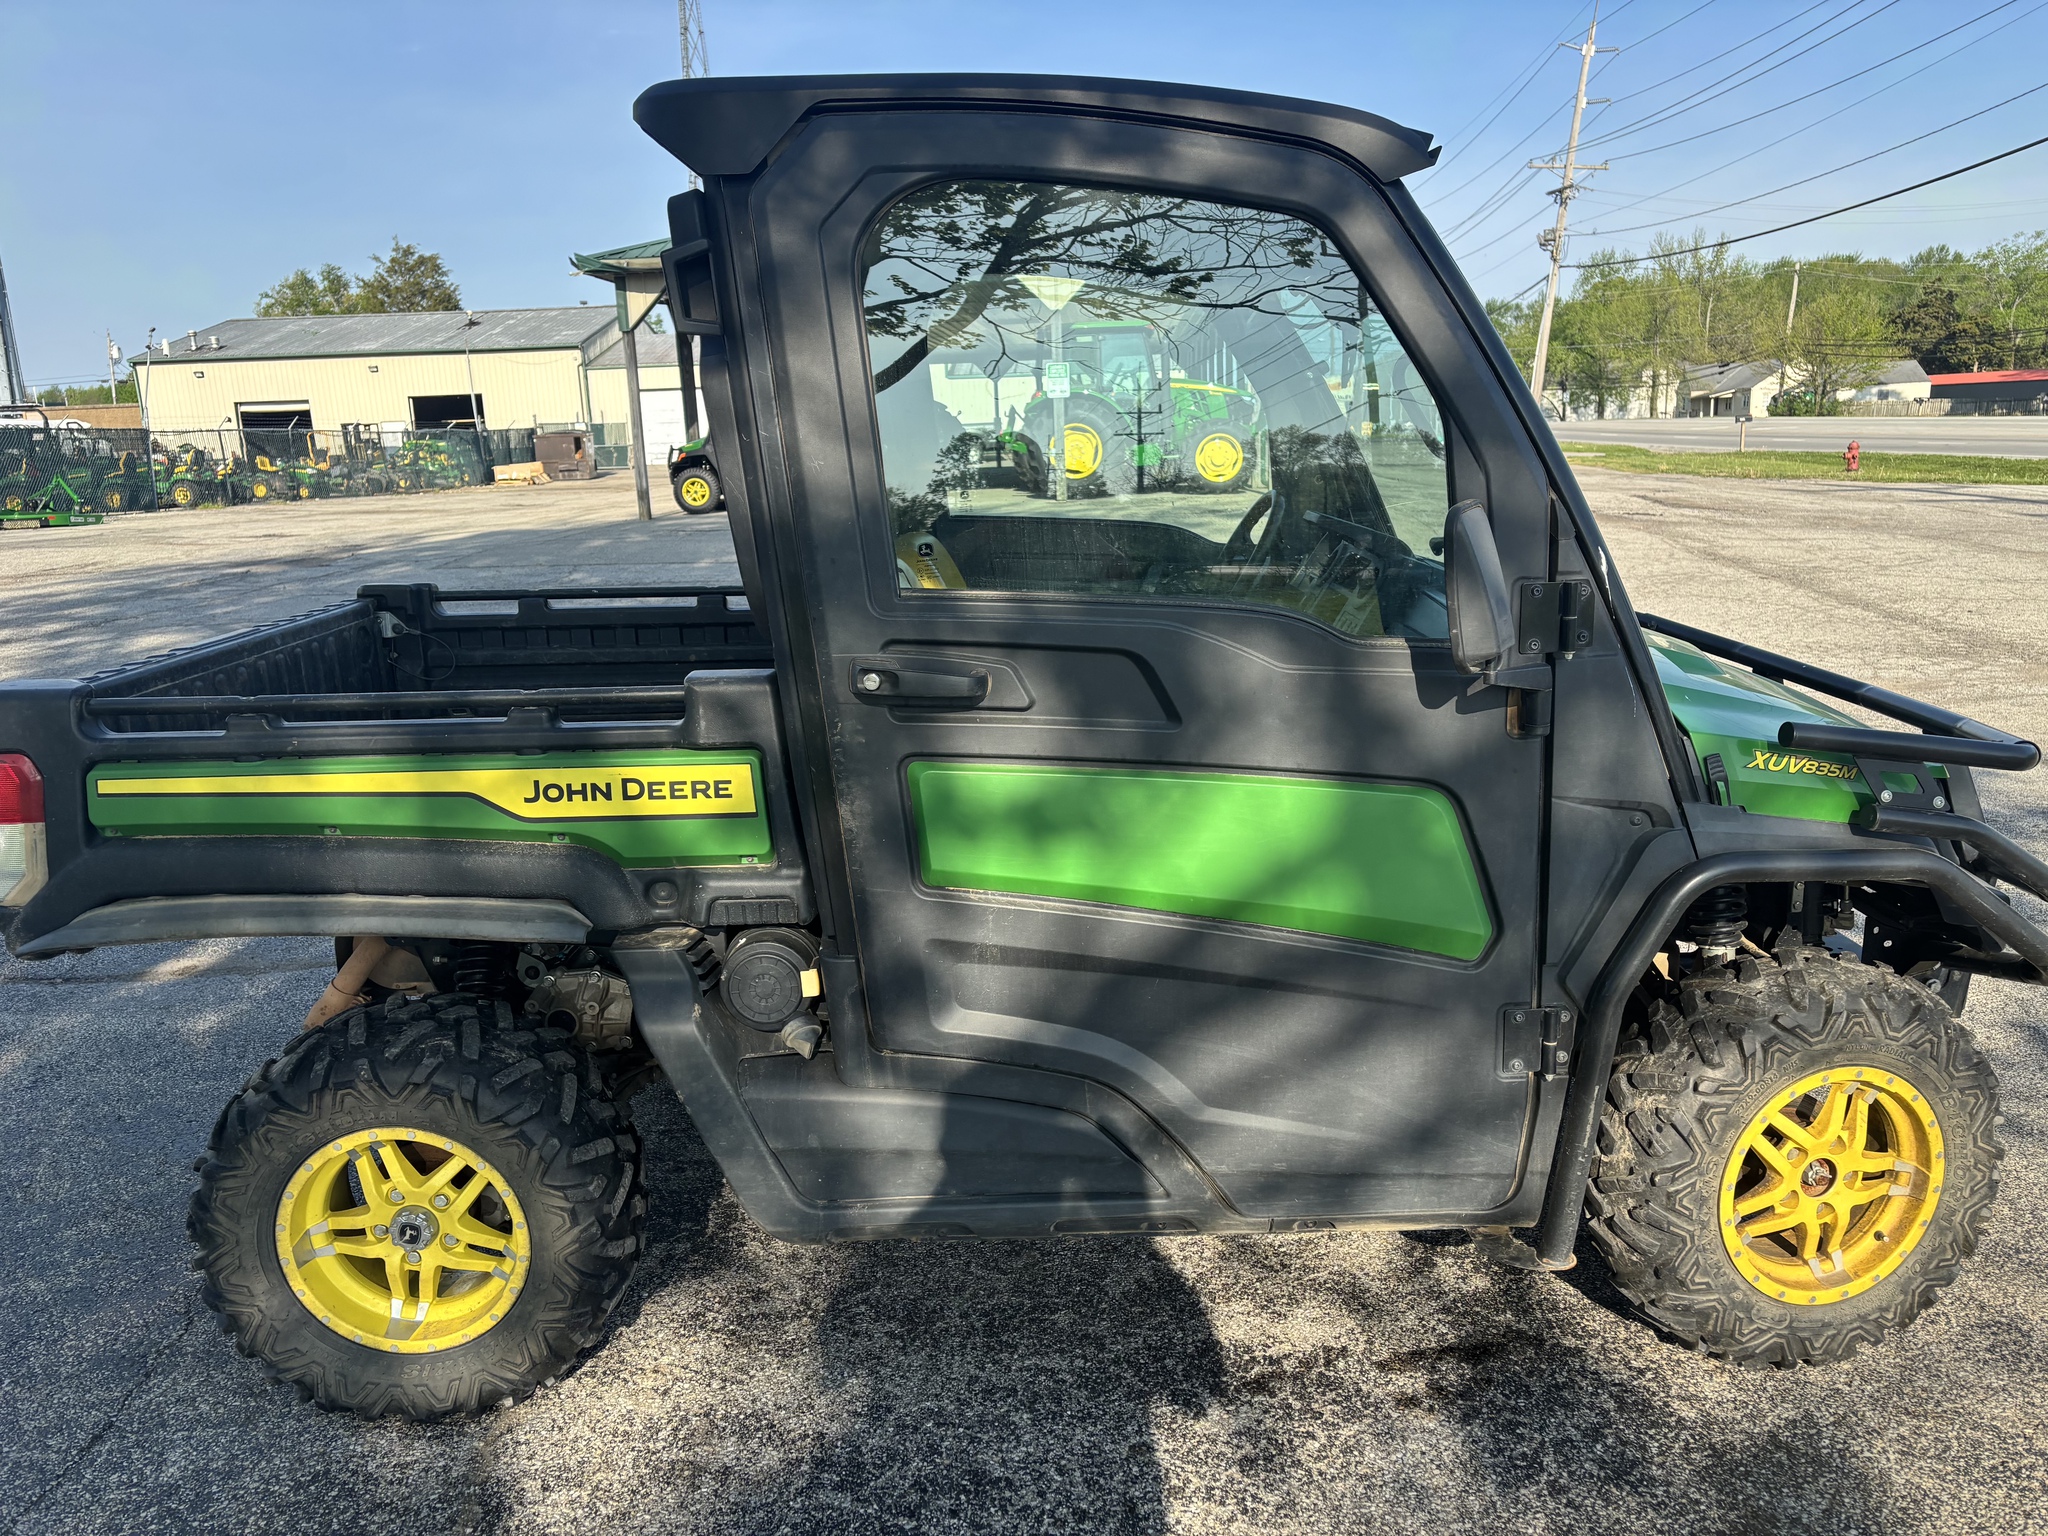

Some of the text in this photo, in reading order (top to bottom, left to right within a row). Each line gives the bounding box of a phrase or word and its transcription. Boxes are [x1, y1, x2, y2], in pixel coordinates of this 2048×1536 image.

[1746, 750, 1859, 780] XUV835M
[524, 778, 733, 803] JOHN DEERE
[1782, 1059, 1799, 1073] NHS
[1845, 1044, 1908, 1060] NYLON RADIAL
[270, 1110, 399, 1168] BIGHORN
[1938, 1093, 1969, 1227] BIGHORN
[400, 1328, 518, 1379] MAXXIS
